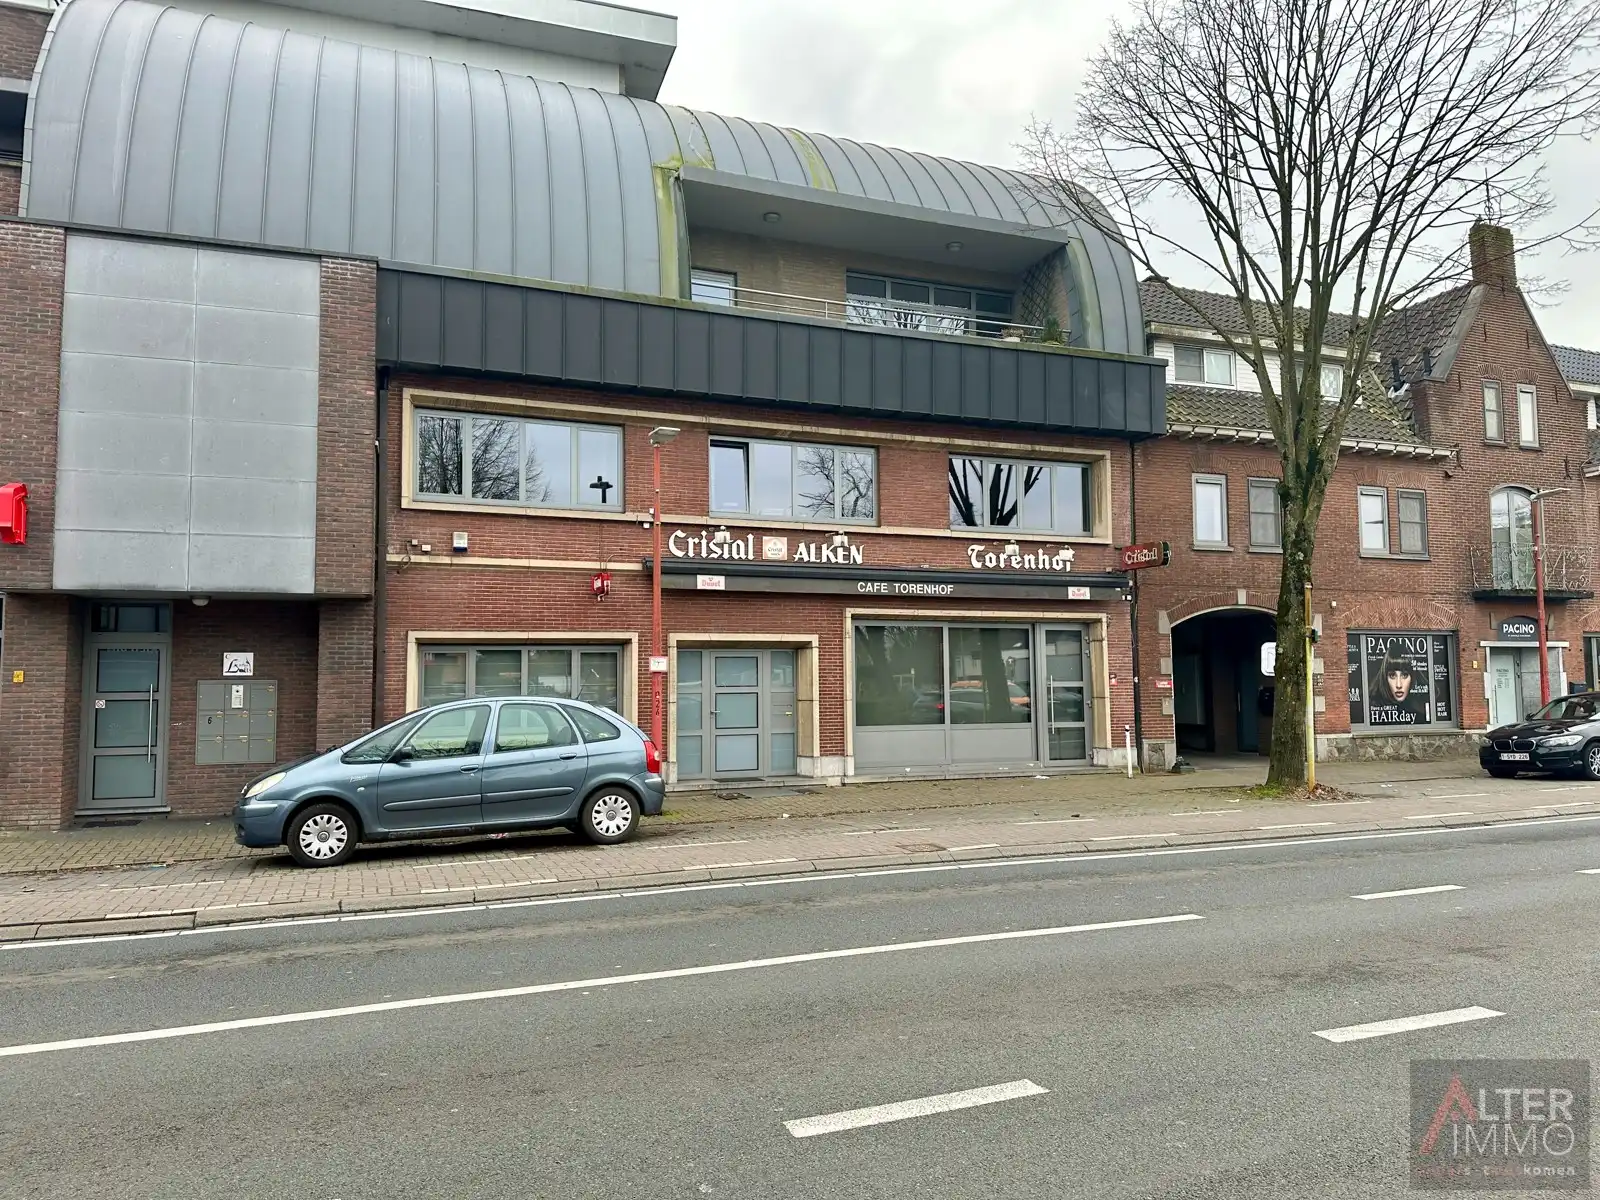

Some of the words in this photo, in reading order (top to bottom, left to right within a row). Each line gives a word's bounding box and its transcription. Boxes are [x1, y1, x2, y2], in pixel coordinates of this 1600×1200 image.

[668, 529, 755, 560] Cristal
[793, 542, 864, 565] ALKEN
[857, 581, 888, 593] CAFE
[893, 583, 954, 595] TORENHOF
[1502, 624, 1535, 634] PACINO
[208, 716, 213, 724] 6
[1371, 710, 1416, 724] HAIRday
